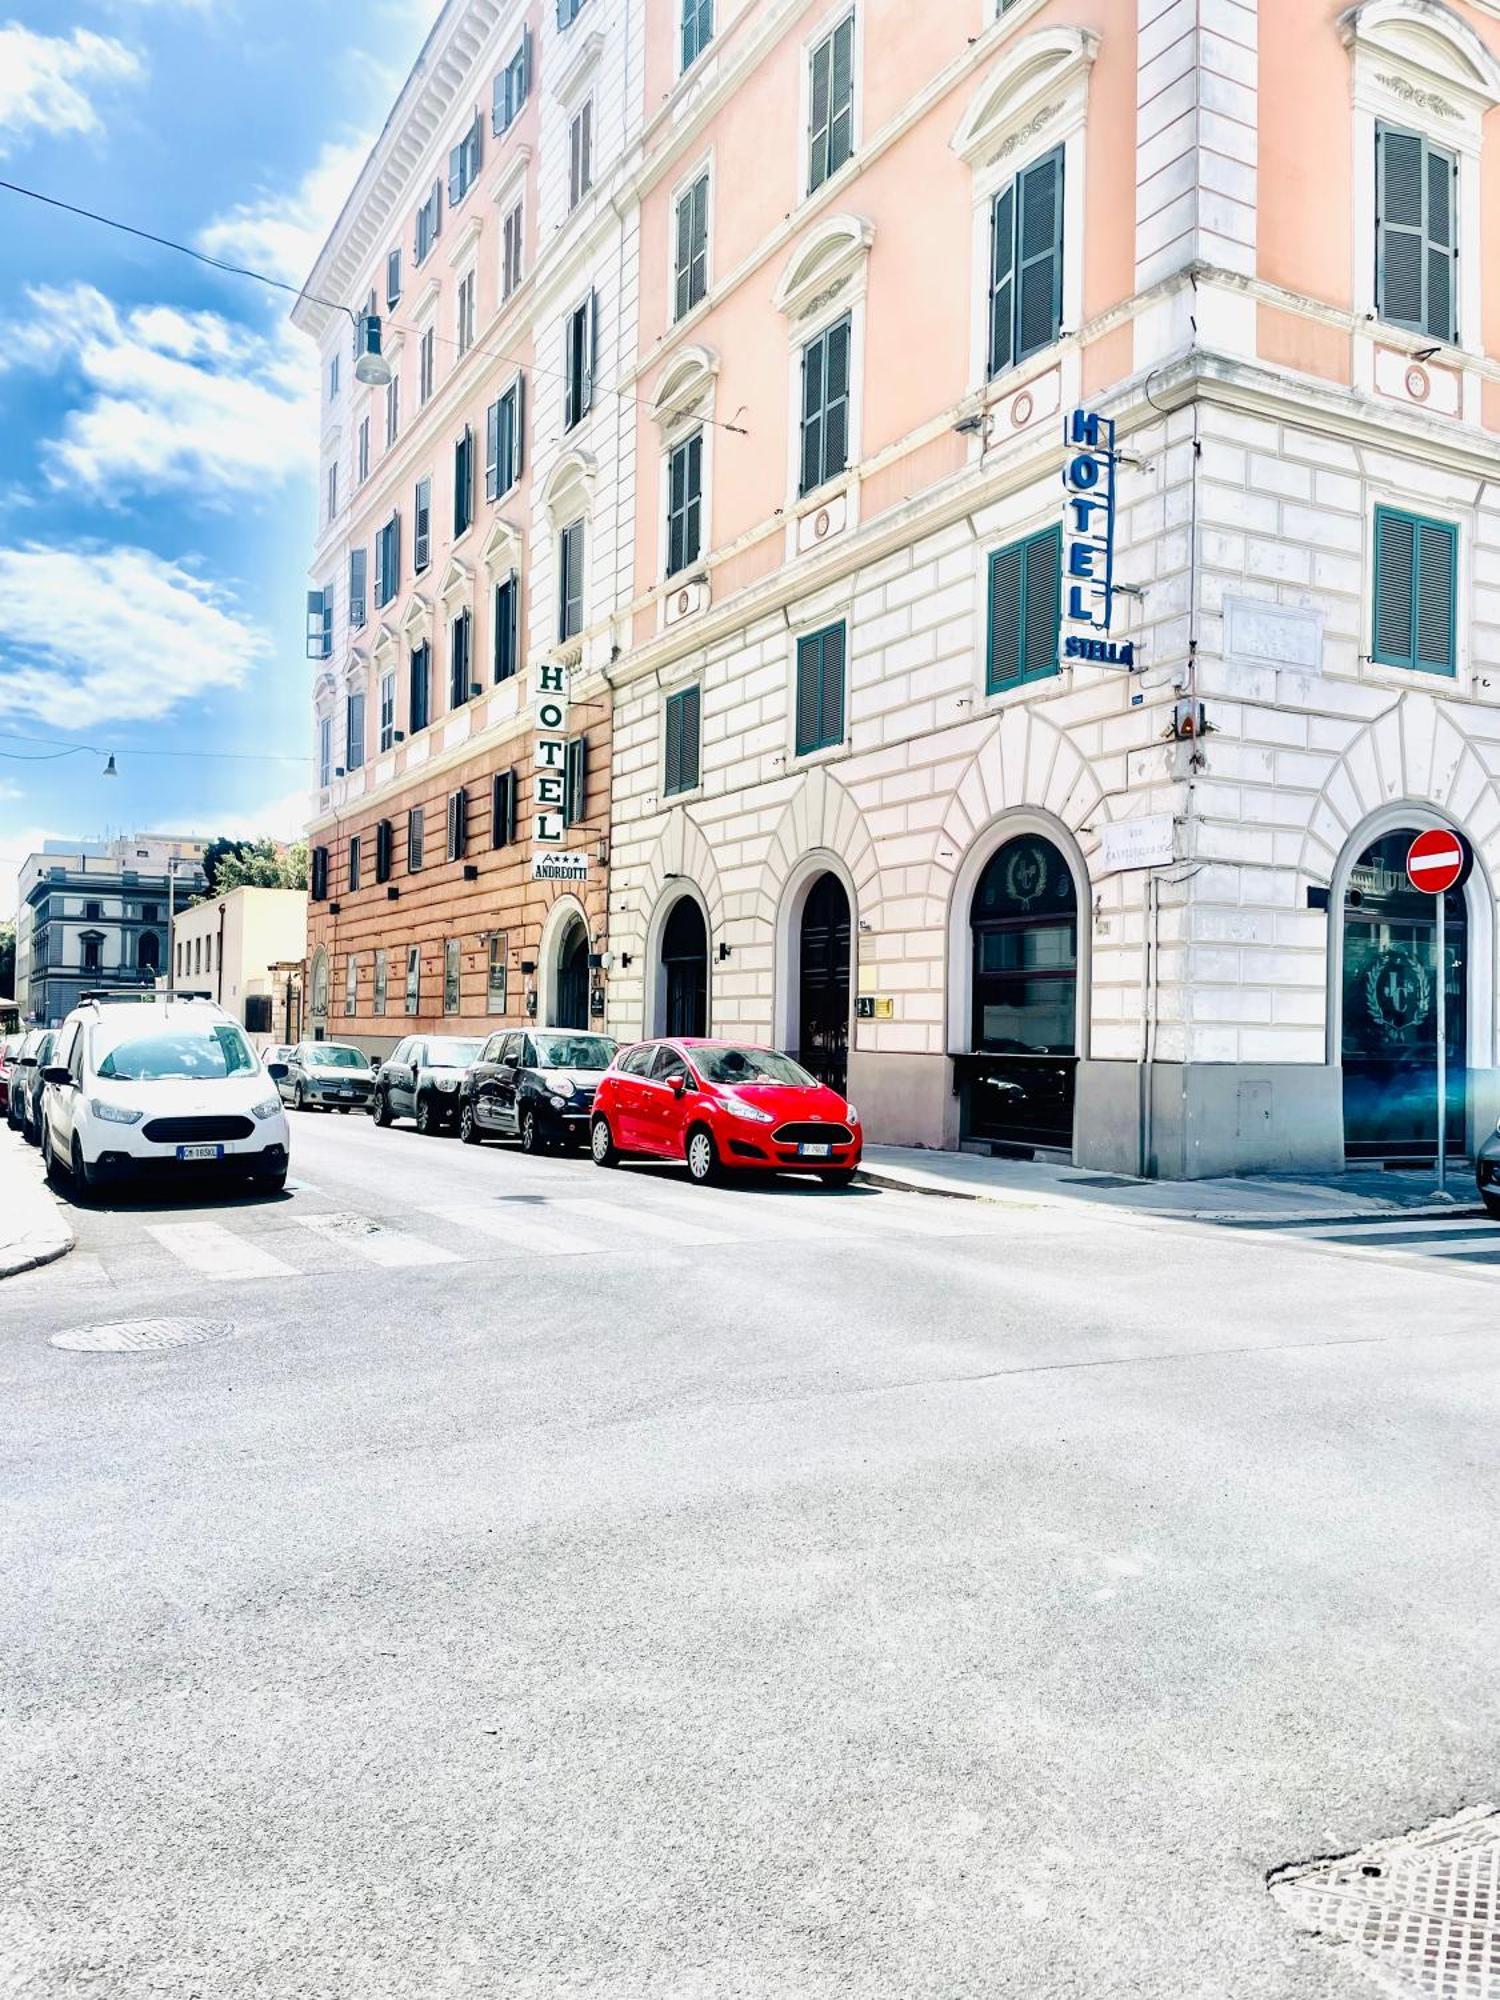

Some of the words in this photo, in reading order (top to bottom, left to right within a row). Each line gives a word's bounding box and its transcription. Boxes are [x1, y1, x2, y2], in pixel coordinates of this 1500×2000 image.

[1069, 409, 1099, 620] HOTEL
[1065, 636, 1133, 665] STELLA
[538, 665, 564, 840] HOTEL
[535, 865, 587, 880] ANDREOTTI
